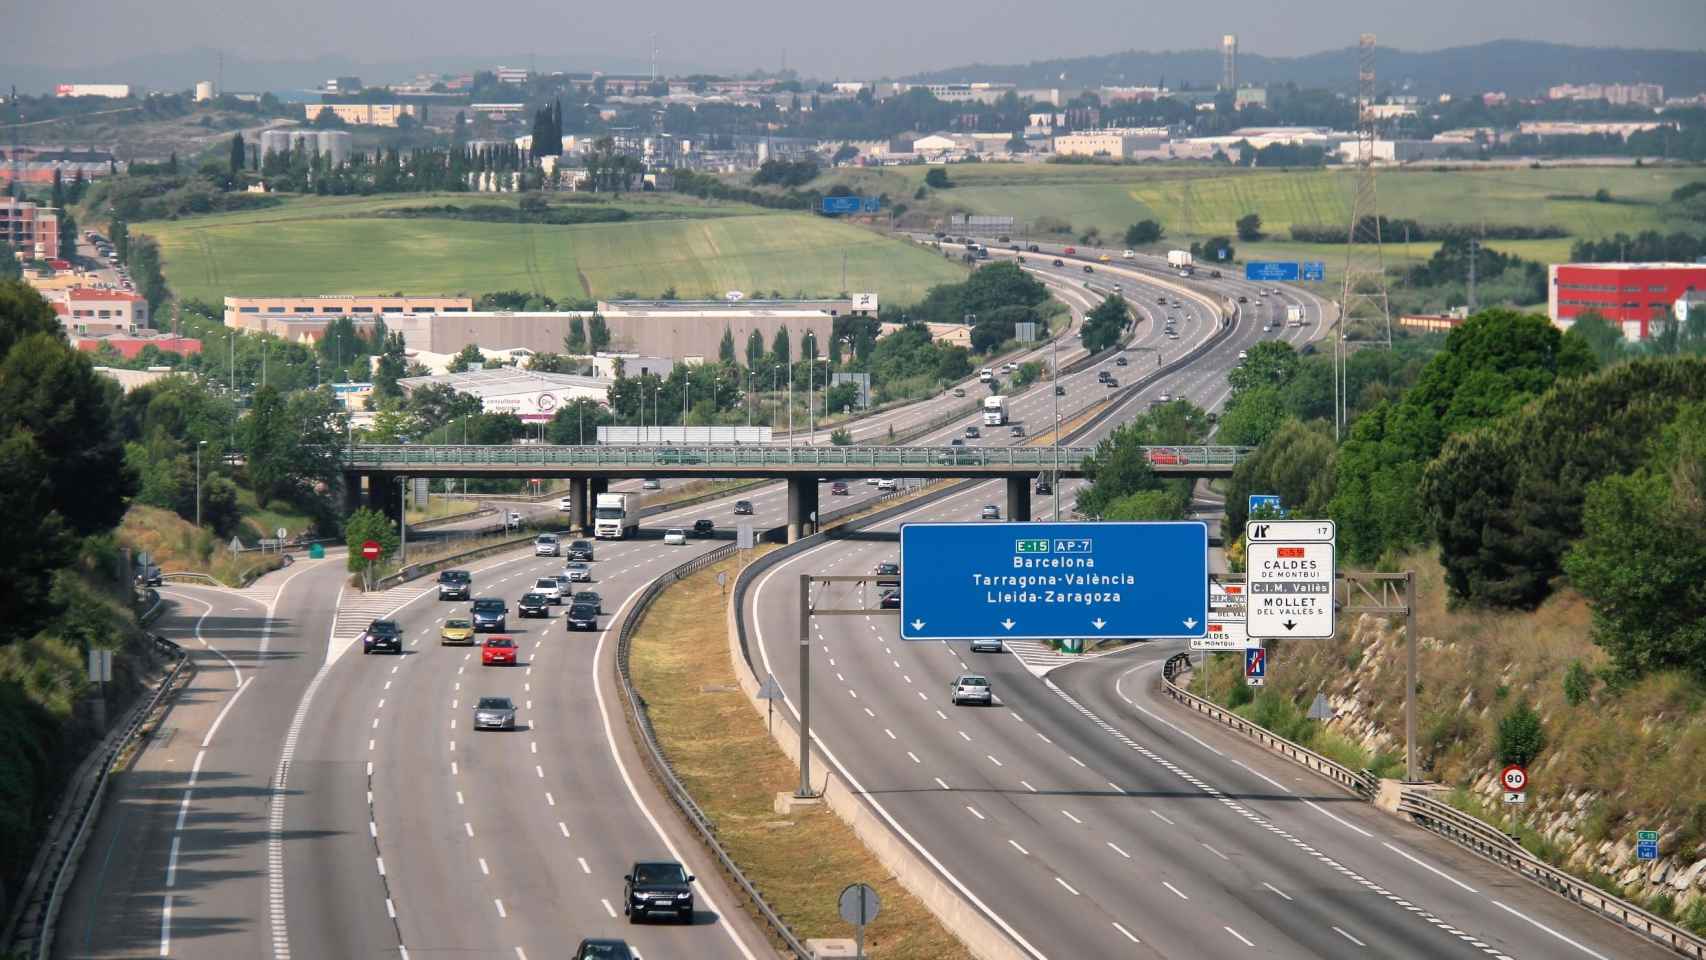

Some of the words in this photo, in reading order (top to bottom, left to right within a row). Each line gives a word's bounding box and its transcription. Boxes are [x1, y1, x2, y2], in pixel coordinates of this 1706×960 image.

[1317, 527, 1328, 535] 17
[1017, 541, 1048, 551] E-15
[1056, 541, 1090, 551] AP-7
[1013, 556, 1095, 568] Barcelona
[1264, 560, 1317, 570] CALDES
[972, 573, 1135, 588] Tarragona-València
[1253, 583, 1288, 592] C.I.M.
[987, 591, 1121, 604] Lleida-Zaragoza
[1264, 598, 1317, 607] MOLLET
[1507, 774, 1522, 783] 90
